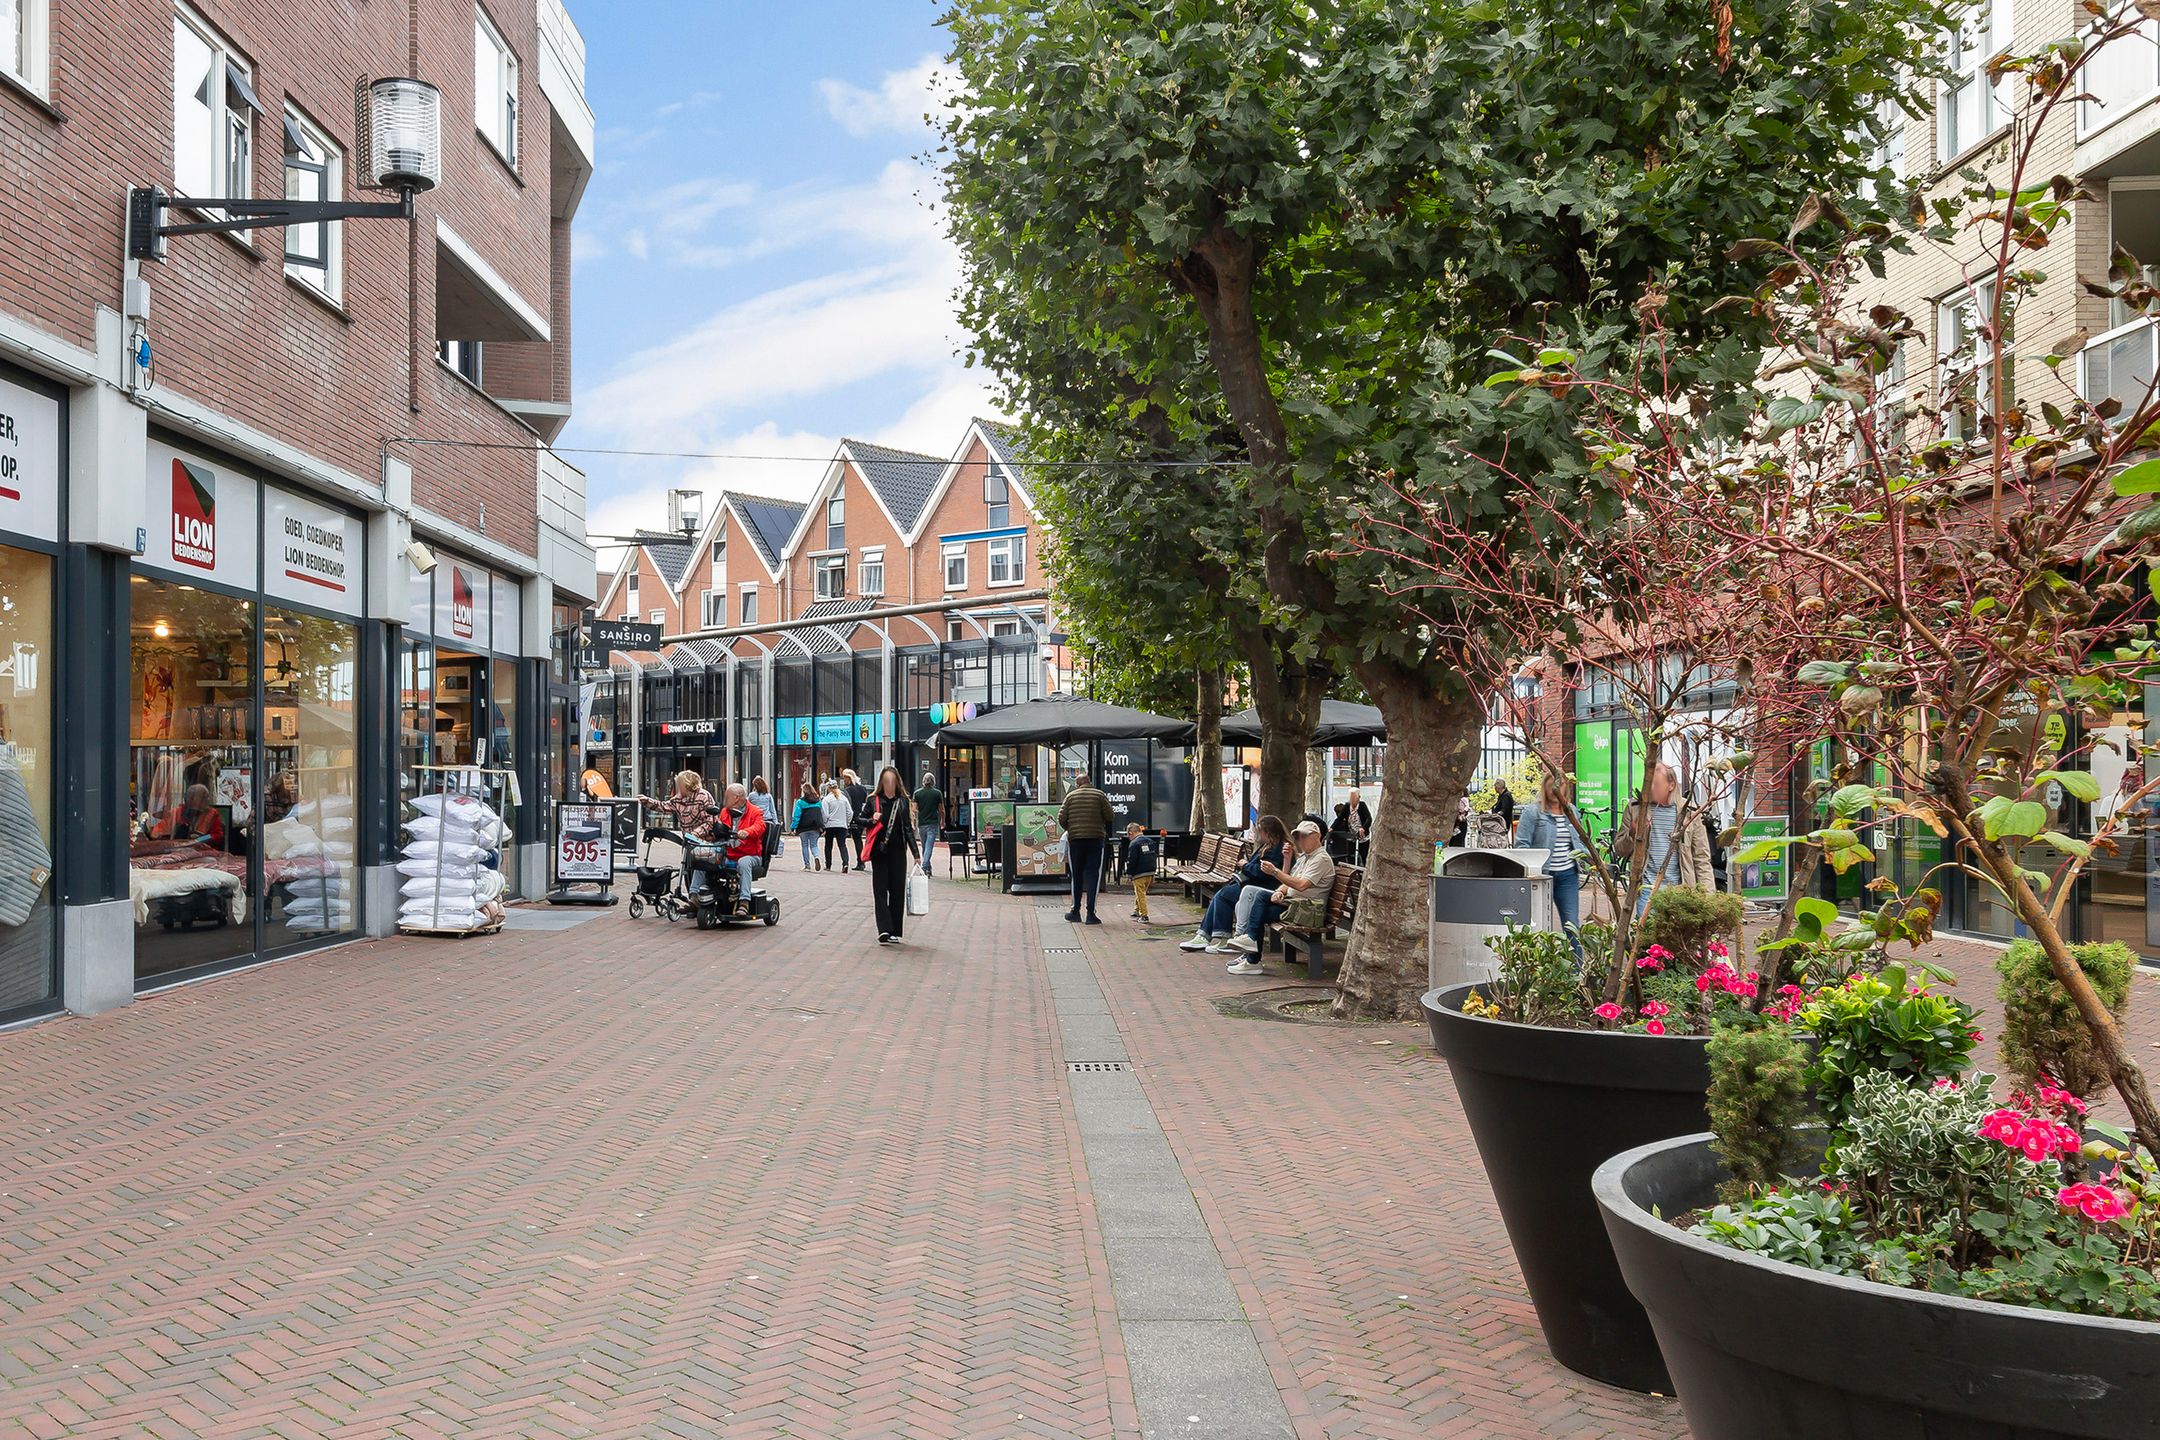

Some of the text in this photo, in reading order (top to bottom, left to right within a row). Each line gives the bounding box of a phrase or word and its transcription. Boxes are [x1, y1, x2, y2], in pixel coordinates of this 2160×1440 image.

[174, 512, 213, 551] LION
[284, 516, 345, 556] GOED, GOEDKOPER,
[174, 541, 213, 564] BEDDENSHOP
[284, 546, 346, 579] LION BEDDENSHOP.
[454, 602, 472, 625] LION
[600, 629, 651, 643] SANSIRO
[696, 721, 716, 733] CECIL
[816, 729, 851, 739] The Party Bear
[1104, 750, 1129, 766] Kom
[1104, 769, 1142, 785] binnen.
[1126, 794, 1136, 802] we
[1111, 803, 1129, 815] zellig.
